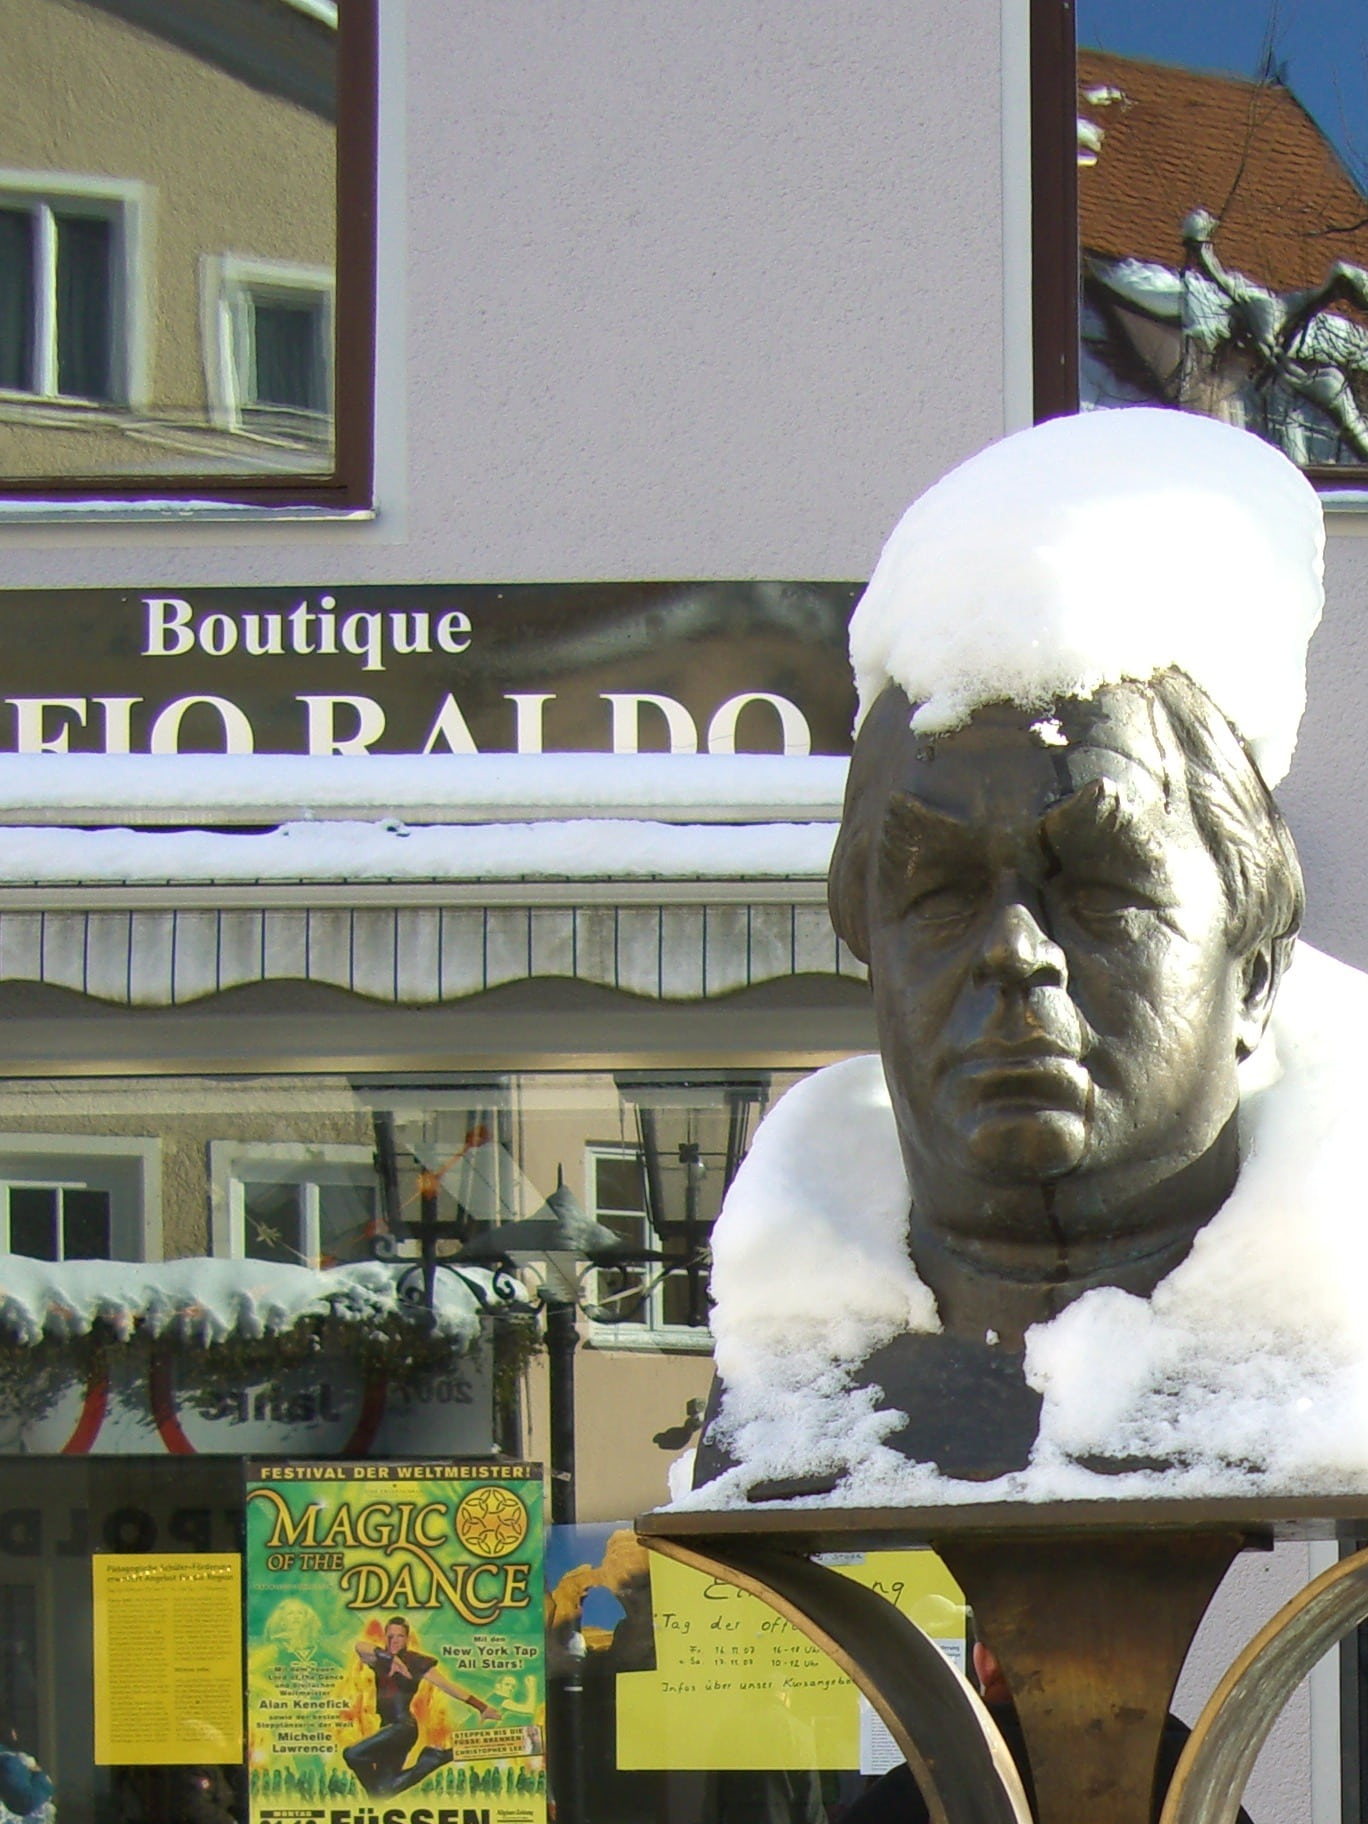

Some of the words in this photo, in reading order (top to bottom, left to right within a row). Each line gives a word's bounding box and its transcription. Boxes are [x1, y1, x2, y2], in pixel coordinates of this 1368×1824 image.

[142, 597, 472, 670] Boutique
[260, 1467, 346, 1480] FESTIVAL
[353, 1467, 390, 1479] DER
[397, 1465, 532, 1479] WELTMEISTER!
[246, 1487, 448, 1548] MAGIC
[267, 1553, 295, 1571] OF
[300, 1553, 344, 1571] THE
[340, 1543, 532, 1625] DANCE
[662, 1612, 691, 1634] Tag
[710, 1615, 741, 1631] der
[442, 1646, 472, 1656] New
[478, 1645, 508, 1656] York
[514, 1646, 537, 1657] Tap
[458, 1659, 476, 1668] All
[482, 1659, 523, 1669] Stars!
[661, 1680, 696, 1693] Infos
[704, 1678, 733, 1692] über
[259, 1700, 288, 1709] Alan
[293, 1700, 350, 1709] Kenefick
[277, 1732, 332, 1741] Michelle
[272, 1744, 339, 1753] Lawrence!
